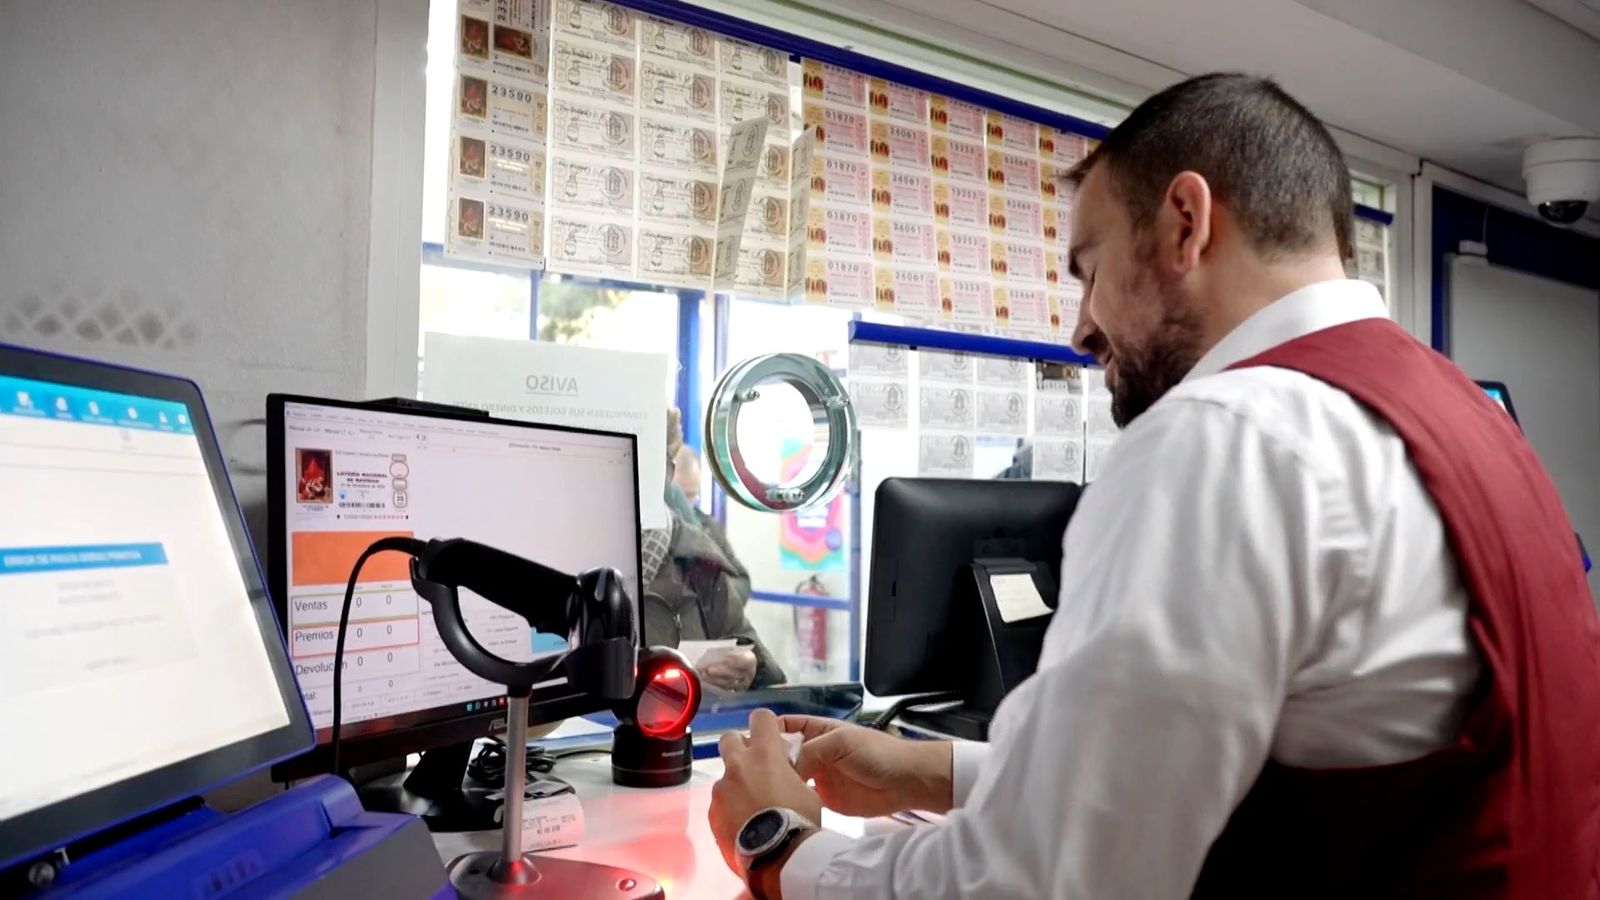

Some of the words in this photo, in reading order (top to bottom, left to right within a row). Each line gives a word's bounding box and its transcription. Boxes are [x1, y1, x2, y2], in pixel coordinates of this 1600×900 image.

[491, 85, 532, 103] 23590
[825, 110, 855, 124] 01870
[490, 145, 530, 162] 23590
[827, 160, 857, 173] 01870
[488, 206, 528, 221] 23590
[827, 210, 858, 222] 01870
[828, 262, 859, 273] 01870
[295, 599, 328, 612] Ventas
[355, 597, 363, 607] 0
[386, 594, 393, 605] 0
[295, 630, 334, 643] Premios
[356, 627, 363, 638] 0
[386, 624, 393, 635] 0
[357, 655, 364, 667] 0
[387, 652, 394, 663] 0
[388, 679, 394, 688] 0
